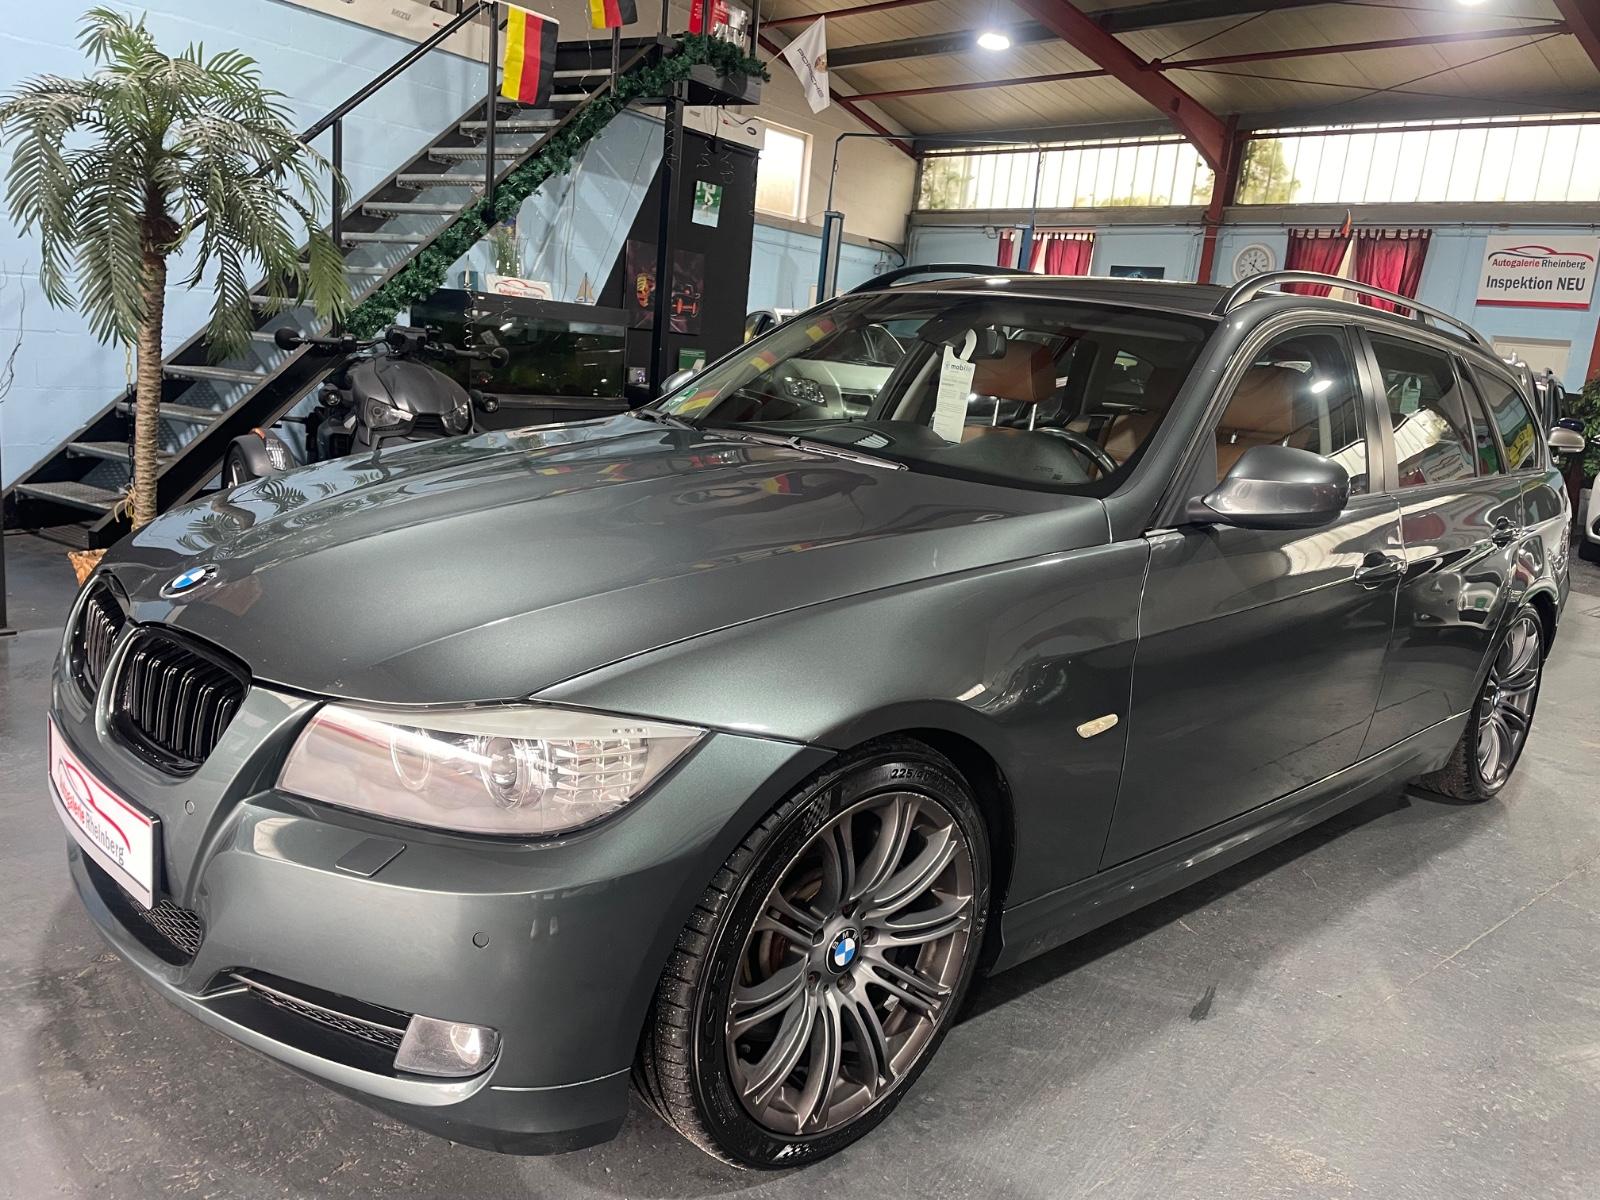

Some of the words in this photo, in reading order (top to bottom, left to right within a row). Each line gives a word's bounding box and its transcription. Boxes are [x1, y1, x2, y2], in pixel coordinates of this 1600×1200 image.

[1492, 258, 1540, 269] Autogalerie
[1541, 259, 1586, 270] Rheinberg
[1486, 275, 1552, 291] Inspektion
[1556, 277, 1586, 291] NEU
[86, 810, 125, 866] Rheinberg
[831, 930, 859, 950] BMW
